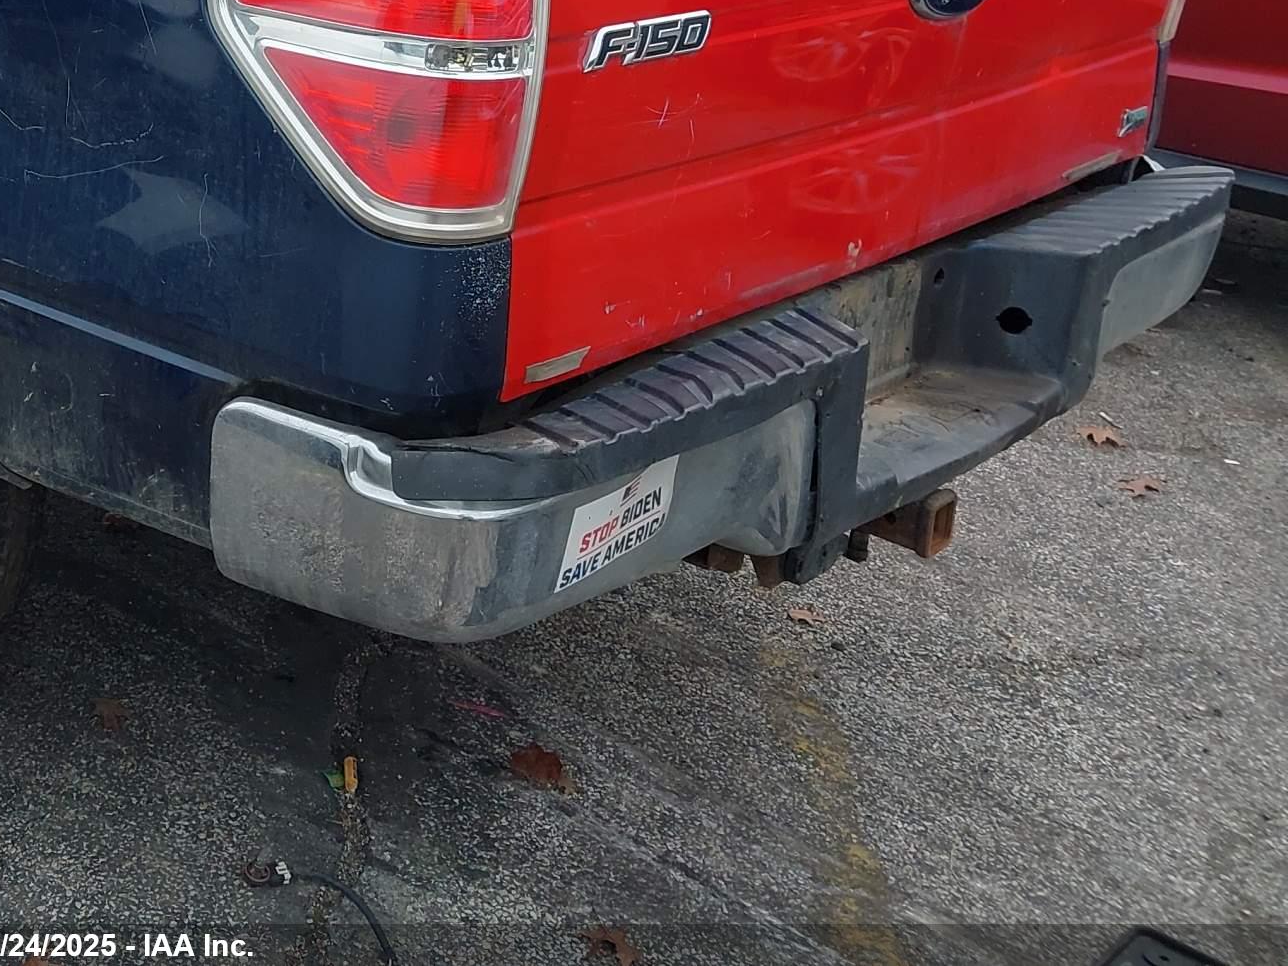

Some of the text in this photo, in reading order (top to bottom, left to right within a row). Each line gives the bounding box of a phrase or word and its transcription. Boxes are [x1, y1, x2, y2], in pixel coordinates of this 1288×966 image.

[583, 10, 712, 75] F-150
[559, 512, 666, 589] SAVE AMERICA
[579, 486, 663, 554] STOP BIDEN
